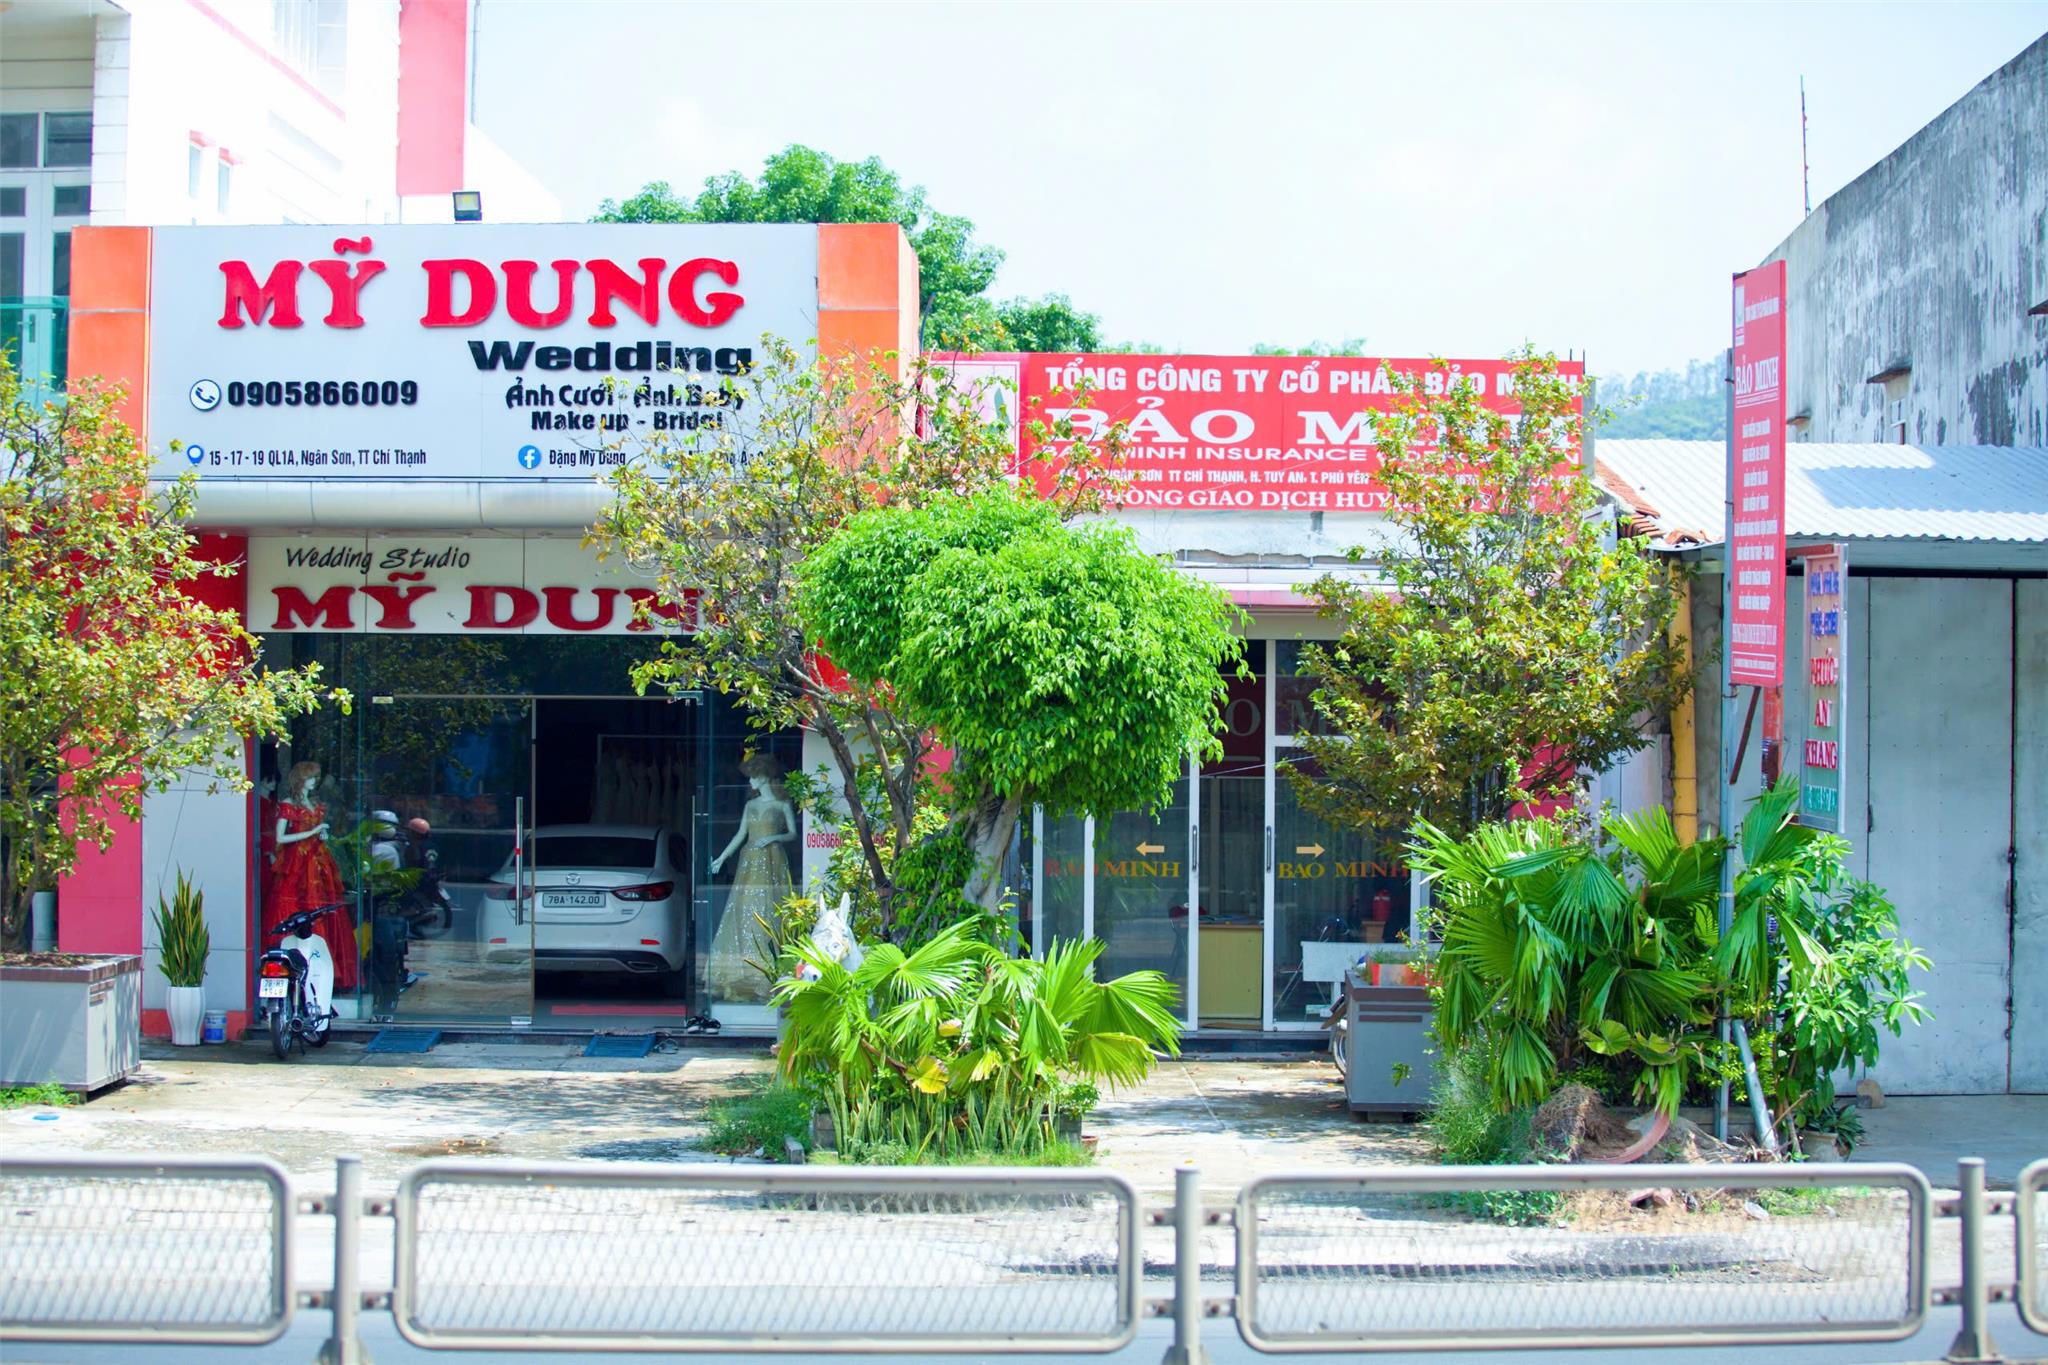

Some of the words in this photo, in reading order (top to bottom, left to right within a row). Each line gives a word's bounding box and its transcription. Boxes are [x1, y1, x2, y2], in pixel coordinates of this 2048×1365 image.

[217, 236, 387, 329] MỸ
[419, 257, 745, 329] DUNG
[467, 340, 753, 376] Wedding
[1045, 357, 1126, 391] TỔNG
[1136, 363, 1222, 392] CÔNG
[1233, 369, 1269, 393] TY
[1279, 360, 1320, 394] CỔ
[227, 380, 418, 407] 0905866009
[505, 376, 555, 409] Ảnh
[558, 382, 614, 407] Cưới
[531, 411, 595, 431] Make
[601, 414, 630, 432] up
[1044, 396, 1255, 444] BẢO
[209, 451, 223, 466] 15
[230, 451, 242, 466] 17
[252, 451, 264, 466] 19
[268, 450, 299, 468] QL1A,
[300, 449, 328, 468] Ngân
[331, 449, 355, 467] Sơn,
[358, 450, 371, 465] TT
[373, 448, 391, 466] Chí
[394, 449, 427, 469] Thạnh
[549, 449, 576, 468] Đặng
[599, 450, 626, 468] Dung
[1197, 446, 1367, 461] INSURANCE
[1168, 470, 1182, 482] TT
[1183, 467, 1203, 482] CHÍ
[1207, 470, 1248, 486] THẠNH,
[1250, 471, 1262, 483] H.
[1264, 471, 1286, 483] TUY
[1321, 468, 1344, 484] PHÚ
[1188, 490, 1254, 506] GIAO
[1260, 490, 1327, 511] DỊCH
[285, 546, 373, 574] Wedding
[379, 546, 470, 569] Studio
[271, 571, 437, 631] MỸ
[1103, 860, 1181, 878] MINH
[1277, 861, 1326, 880] BAO
